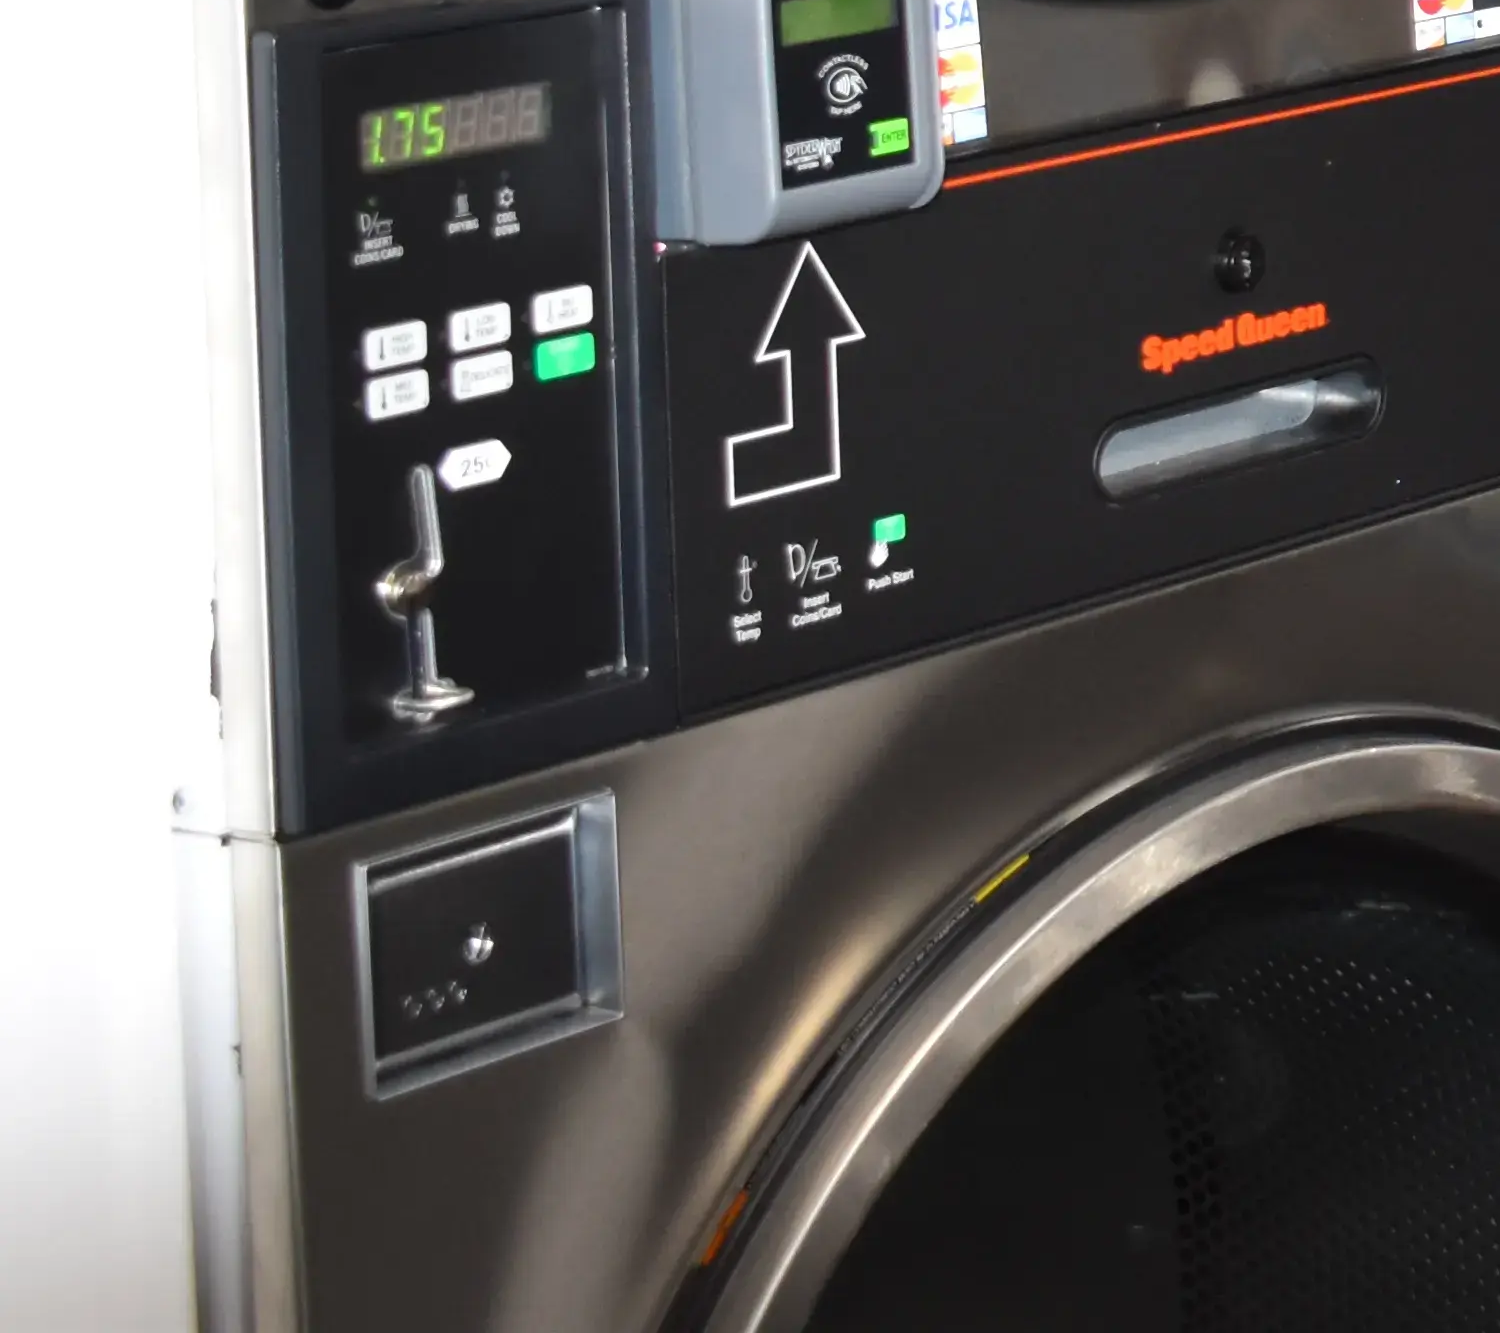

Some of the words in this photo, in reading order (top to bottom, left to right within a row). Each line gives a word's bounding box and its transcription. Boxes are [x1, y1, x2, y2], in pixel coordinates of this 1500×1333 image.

[371, 103, 445, 166] 1.75
[881, 129, 907, 143] ENTER
[1141, 319, 1235, 375] Speed
[1236, 302, 1328, 347] Queen
[867, 574, 891, 591] Push
[892, 568, 915, 585] Start
[803, 592, 830, 608] Insert
[734, 611, 762, 628] Select
[791, 604, 842, 627] Coins/Card
[735, 627, 761, 642] Temp
